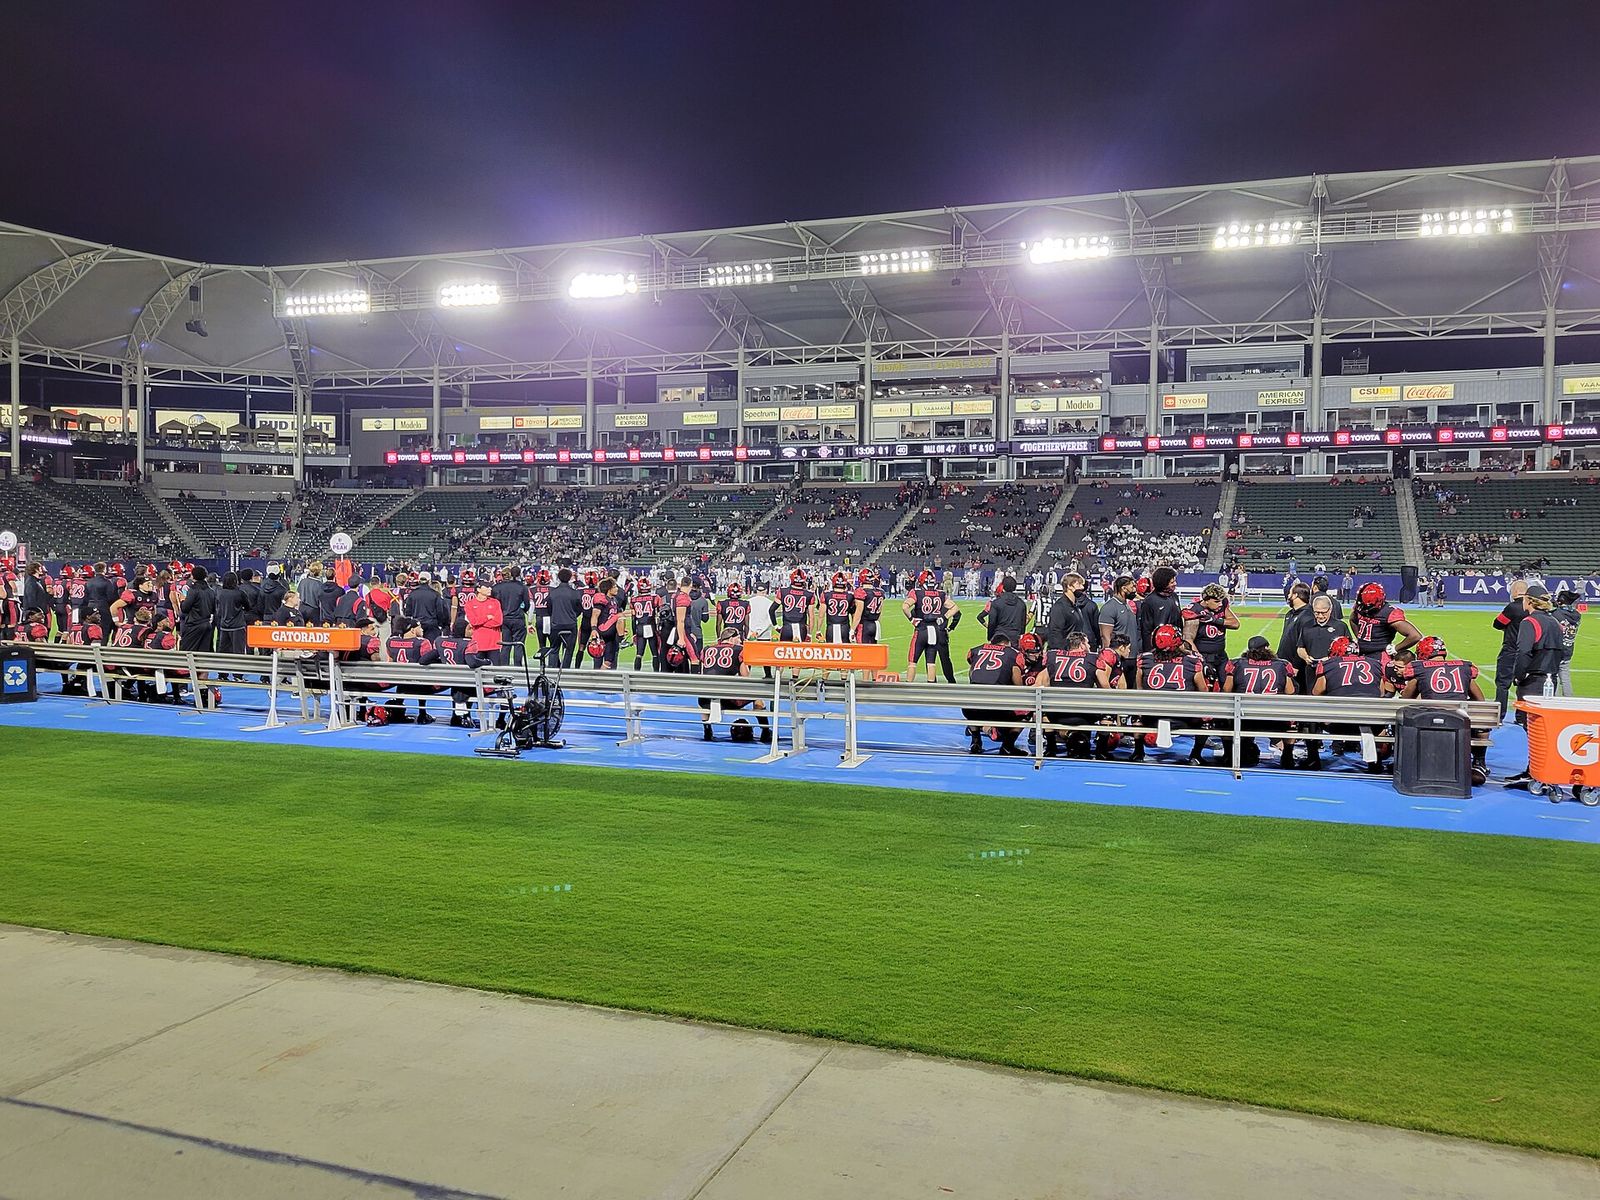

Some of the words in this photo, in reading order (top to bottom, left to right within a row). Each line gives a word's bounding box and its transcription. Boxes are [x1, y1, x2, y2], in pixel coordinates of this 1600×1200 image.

[1178, 397, 1206, 405] TOYOTA
[1259, 391, 1304, 400] AMERICAN
[1265, 397, 1304, 405] EXPRESS
[1065, 400, 1094, 410] Modelo
[744, 411, 775, 419] Spectrum
[1401, 432, 1432, 440] TOYOTA
[1453, 431, 1485, 439] TOYOTA
[1507, 429, 1540, 438] TOYOTA
[1563, 427, 1598, 436] TOYOTA
[1116, 440, 1142, 448] TOYOTA
[1160, 439, 1187, 447] TOYOTA
[1206, 438, 1233, 446] TOYOTA
[1253, 436, 1281, 444] TOYOTA
[1301, 435, 1330, 443] TOYOTA
[1350, 434, 1380, 442] TOYOTA
[801, 449, 807, 457] 0
[838, 448, 844, 456] 0
[946, 444, 957, 453] 47
[1459, 578, 1489, 594] LA
[633, 601, 654, 618] 84
[783, 594, 807, 614] 94
[827, 598, 849, 617] 32
[921, 596, 942, 615] 82
[725, 605, 746, 624] 29
[1357, 619, 1374, 642] 71
[271, 630, 330, 644] GATORADE
[397, 648, 409, 664] 4
[703, 646, 734, 669] 88
[774, 646, 852, 661] GATORADE
[974, 649, 1005, 671] 75
[1054, 656, 1087, 683] 76
[1338, 660, 1374, 686] 73
[1147, 663, 1186, 691] 64
[1243, 667, 1278, 695] 72
[1430, 666, 1465, 694] 61
[1556, 723, 1600, 766] G
